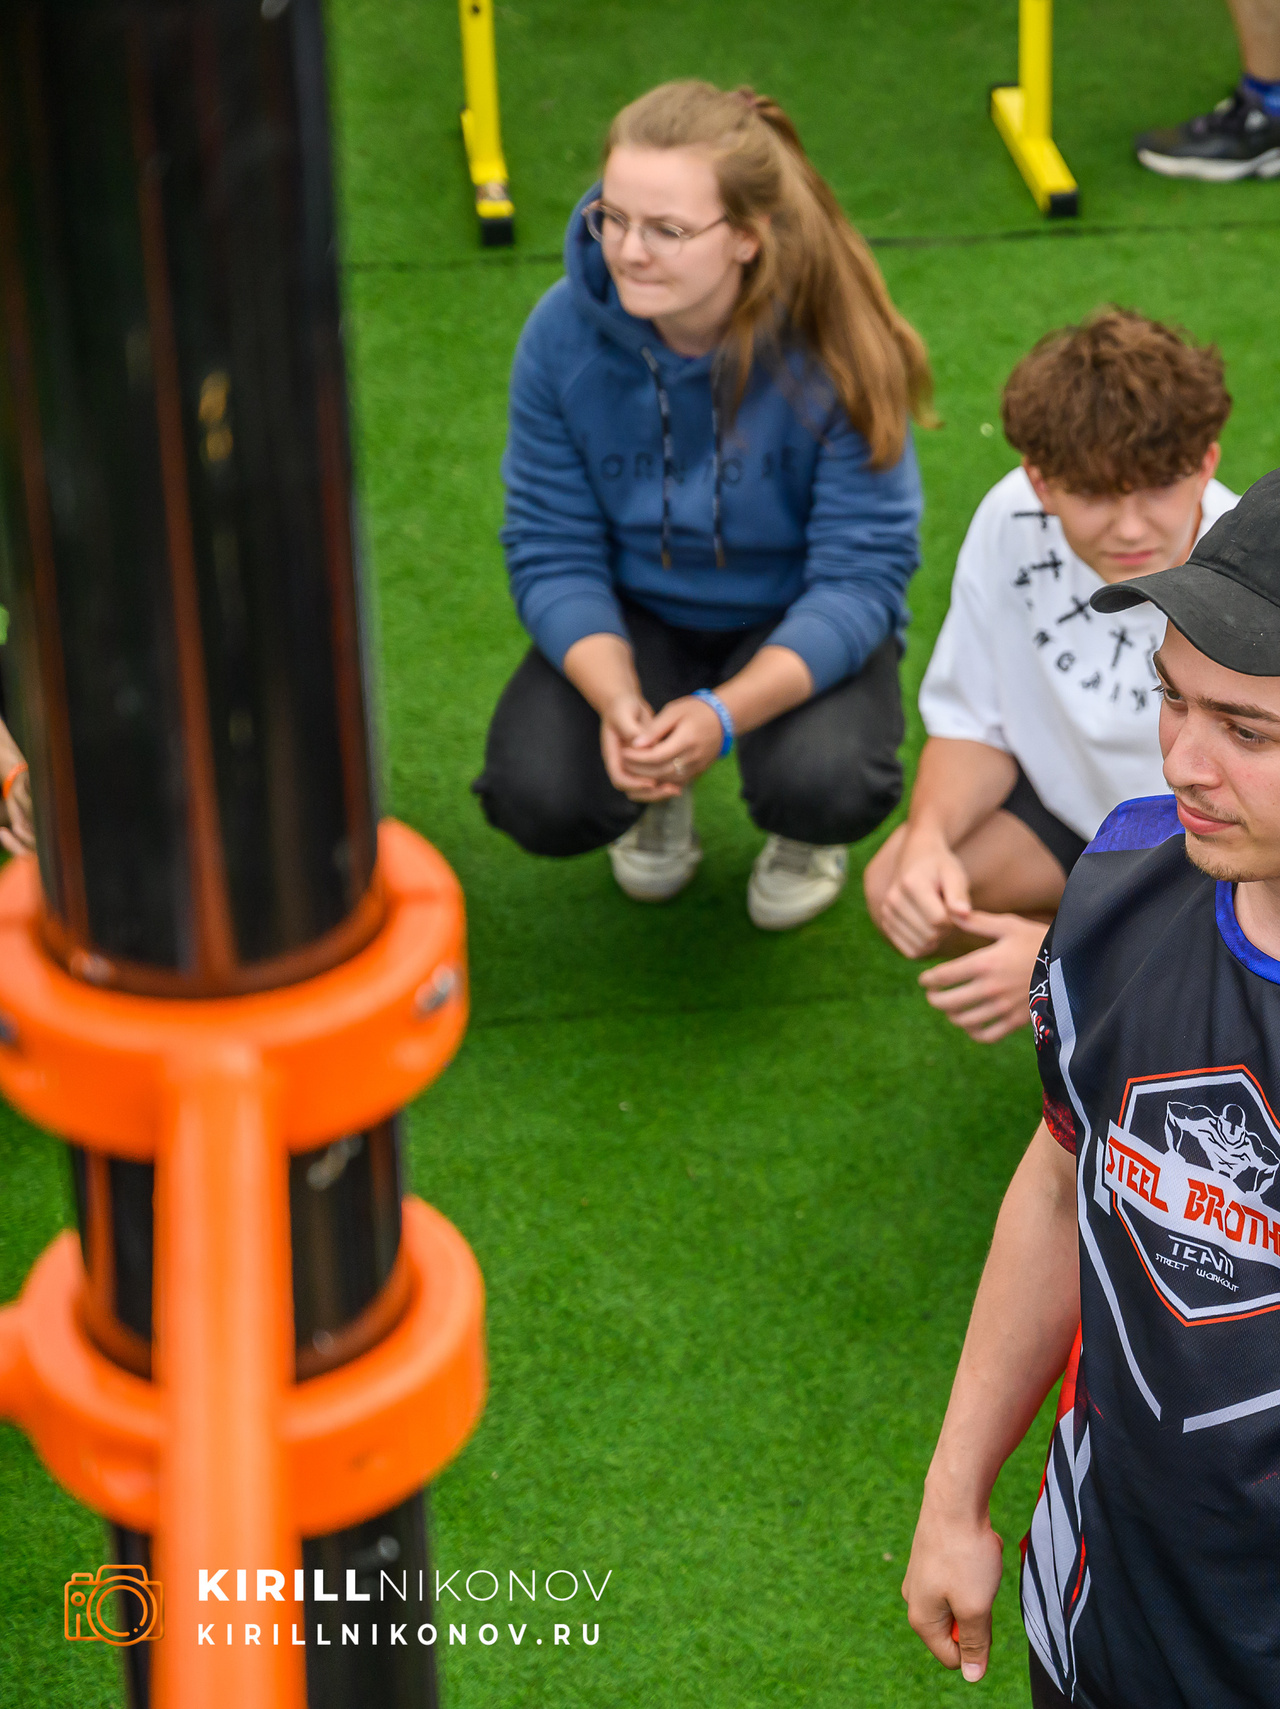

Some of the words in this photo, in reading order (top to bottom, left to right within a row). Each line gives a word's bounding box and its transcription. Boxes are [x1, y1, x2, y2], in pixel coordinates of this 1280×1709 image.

[1106, 1135, 1169, 1213] STEEL
[1155, 1252, 1190, 1272] STREET
[1195, 1268, 1240, 1293] WORKOUT
[1168, 1234, 1234, 1279] TEAM
